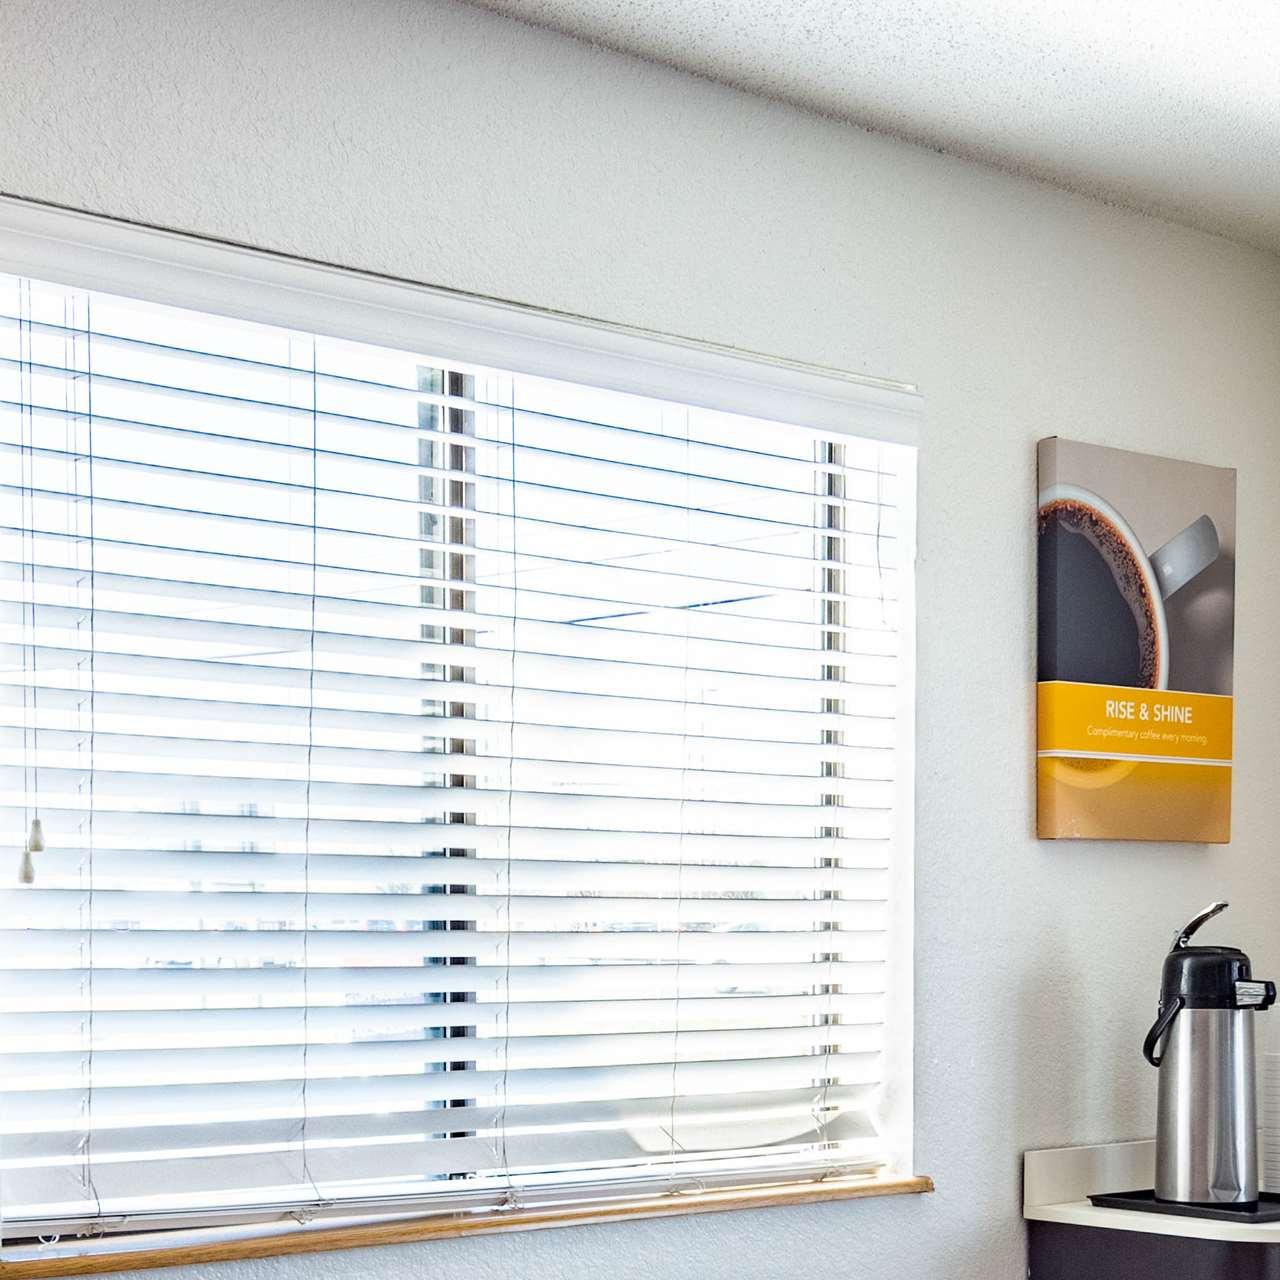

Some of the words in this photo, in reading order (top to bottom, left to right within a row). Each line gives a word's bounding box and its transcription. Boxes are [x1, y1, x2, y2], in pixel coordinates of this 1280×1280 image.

[1105, 700, 1135, 720] RISE
[1139, 703, 1150, 721] &
[1153, 704, 1193, 724] SHINE
[1087, 725, 1139, 741] Complimentary
[1139, 728, 1161, 740] coffee
[1161, 732, 1180, 744] every
